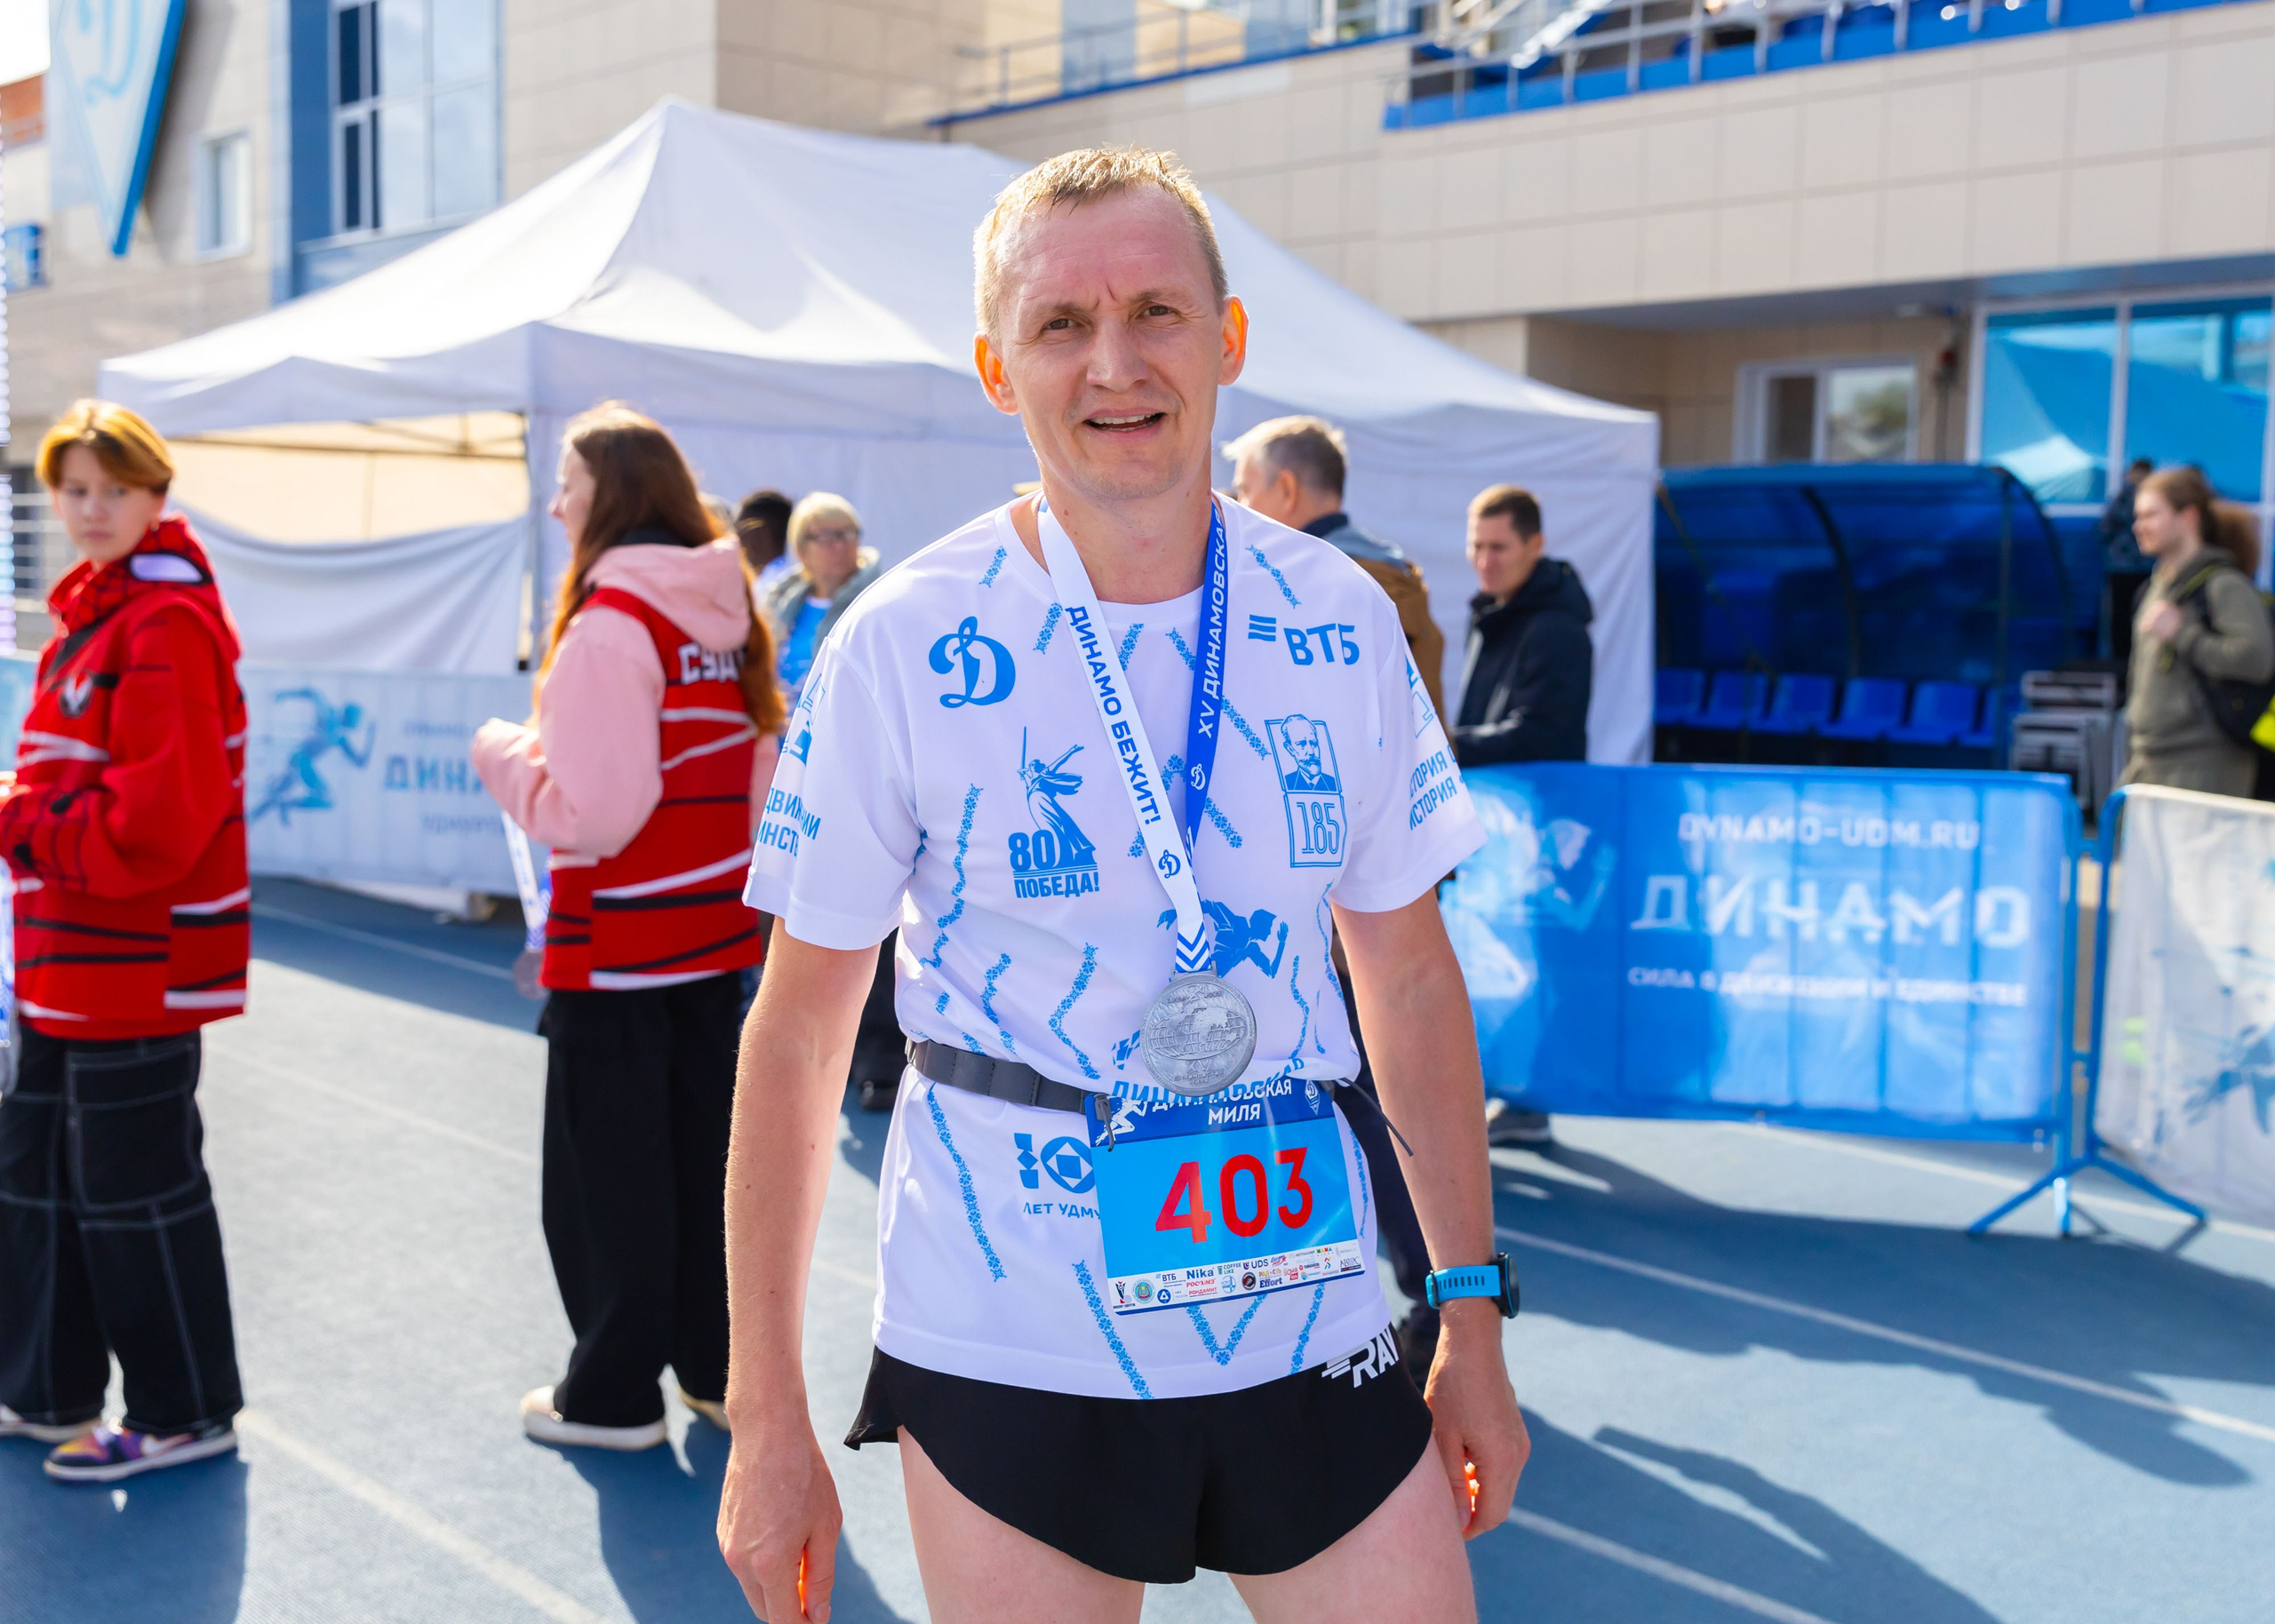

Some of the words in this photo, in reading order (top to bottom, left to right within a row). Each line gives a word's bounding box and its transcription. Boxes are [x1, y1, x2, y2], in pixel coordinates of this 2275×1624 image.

[1202, 508, 1225, 701] ДИНАМОВСКАЯ
[1283, 623, 1360, 665] ВТБ
[1065, 606, 1122, 716] ДИНАМО
[1111, 720, 1161, 825] БЕЖИТ!
[1198, 700, 1216, 739] XV
[1297, 801, 1341, 855] 185
[1009, 829, 1056, 872] 80
[1014, 872, 1099, 898] ПОБЕДА!
[1630, 874, 2032, 949] ДИНАМО
[1208, 1103, 1260, 1126] МИЛЯ
[1155, 1147, 1313, 1244] 403
[1161, 1273, 1177, 1282] ВТБ
[1186, 1268, 1215, 1280] Nika
[1251, 1258, 1269, 1269] UDS
[1259, 1277, 1282, 1288] Effort
